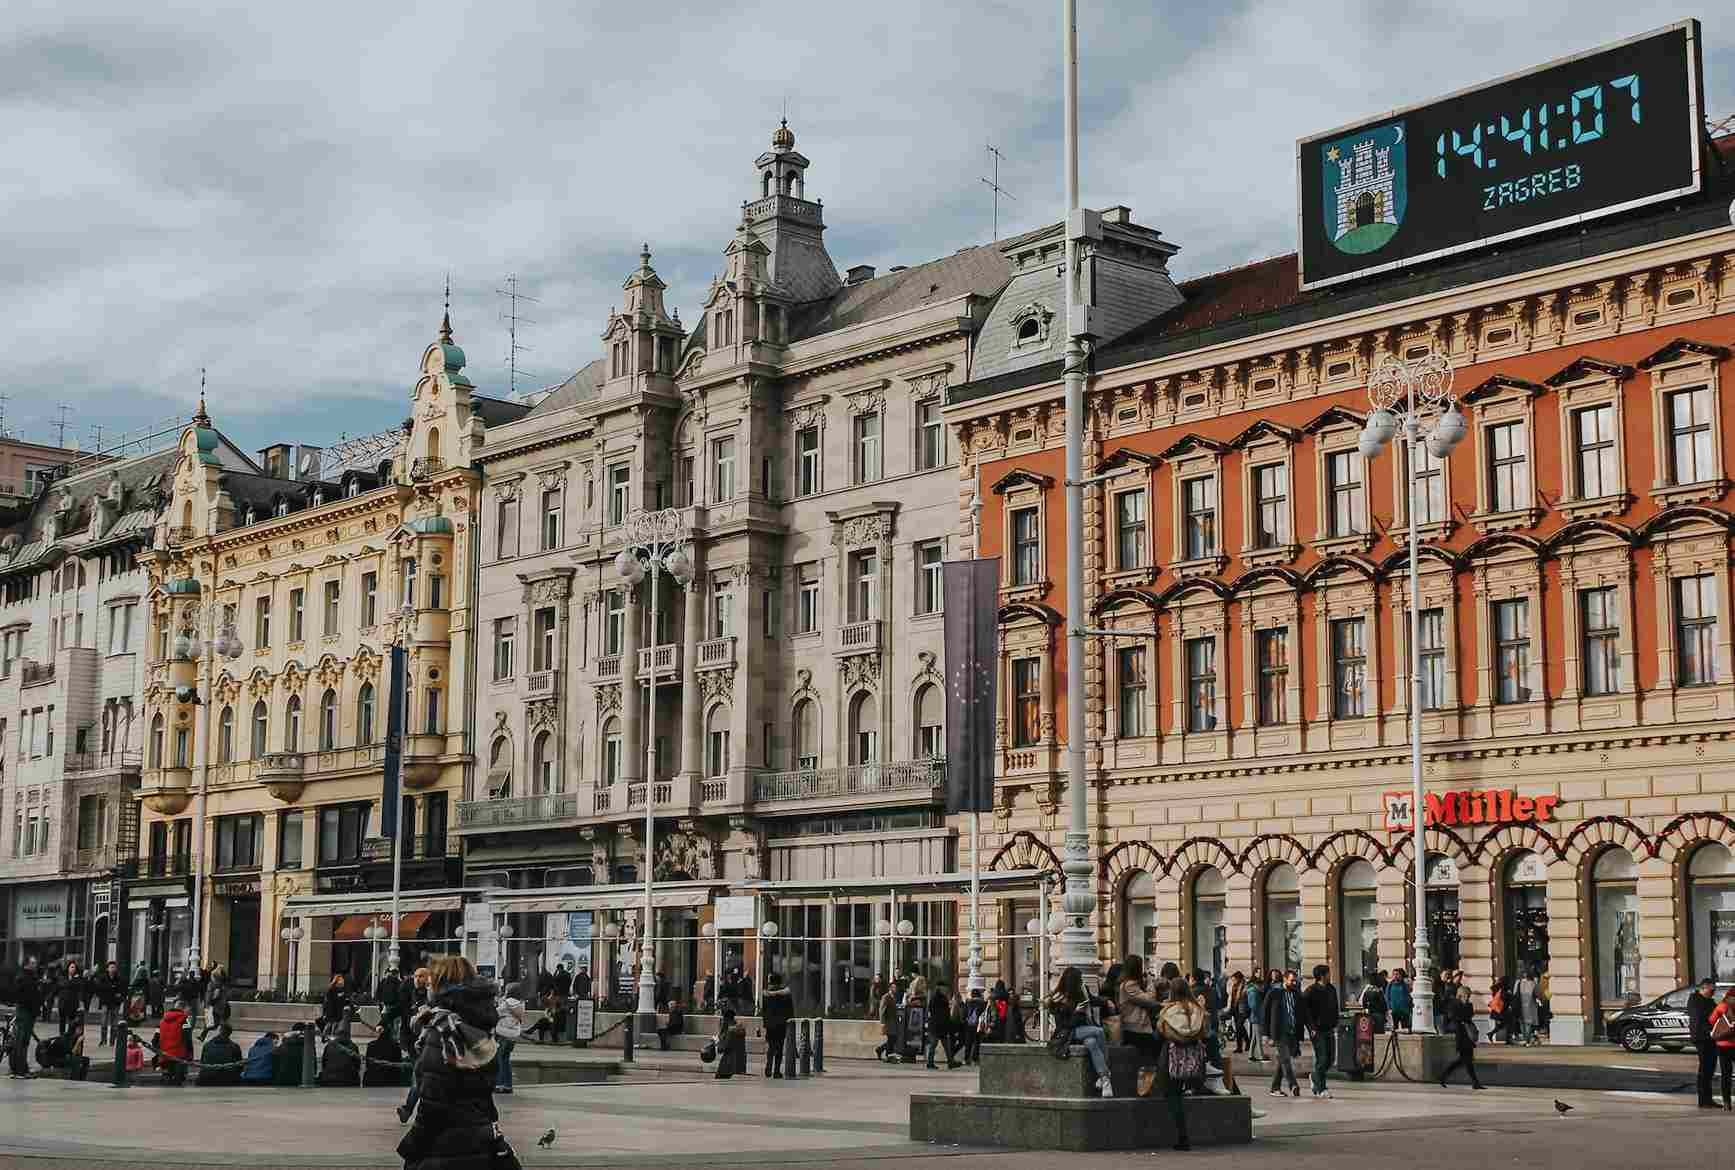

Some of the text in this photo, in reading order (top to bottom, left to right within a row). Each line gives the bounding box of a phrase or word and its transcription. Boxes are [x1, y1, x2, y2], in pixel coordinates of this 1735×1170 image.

[1436, 73, 1641, 179] 14:41:07
[1483, 164, 1582, 211] ZAGREB
[1391, 789, 1558, 827] M Müller
